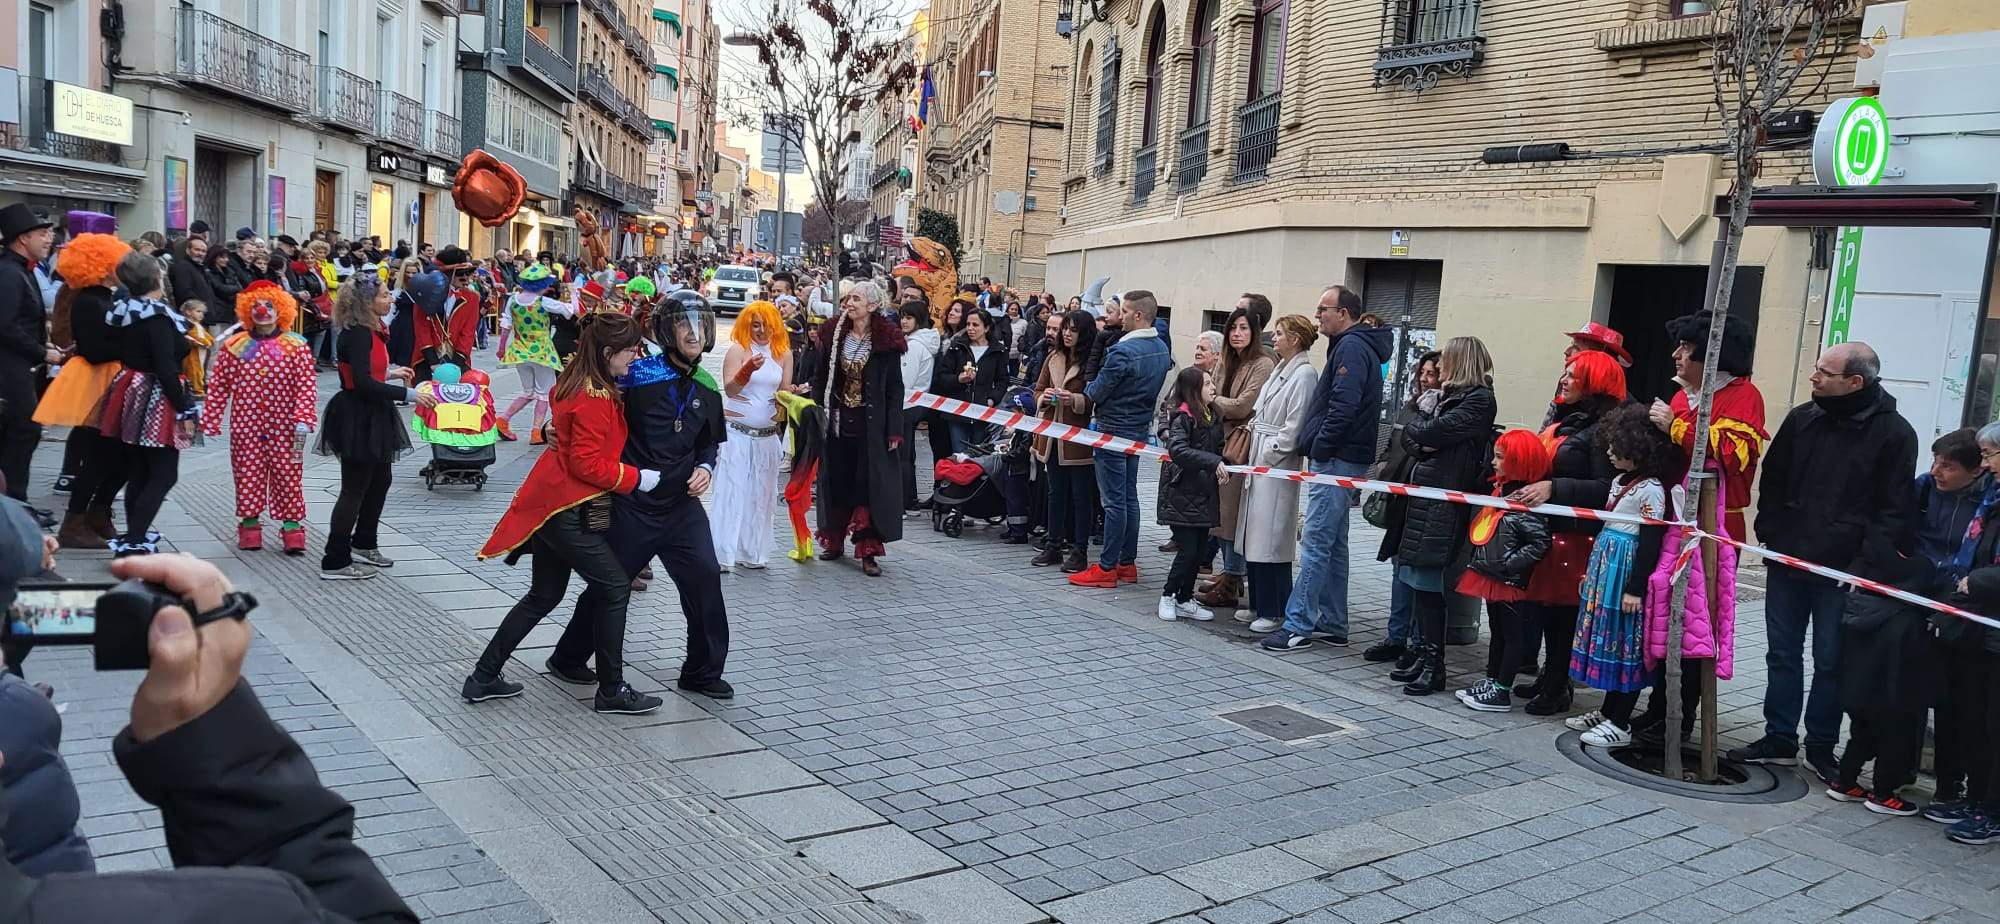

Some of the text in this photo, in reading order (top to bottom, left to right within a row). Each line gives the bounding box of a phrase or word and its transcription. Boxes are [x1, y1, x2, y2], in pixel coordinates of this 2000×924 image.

[86, 111, 122, 127] DE HUESCA
[1852, 107, 1881, 129] PLAZA
[659, 140, 667, 205] FARMACIA
[457, 410, 462, 422] 1
